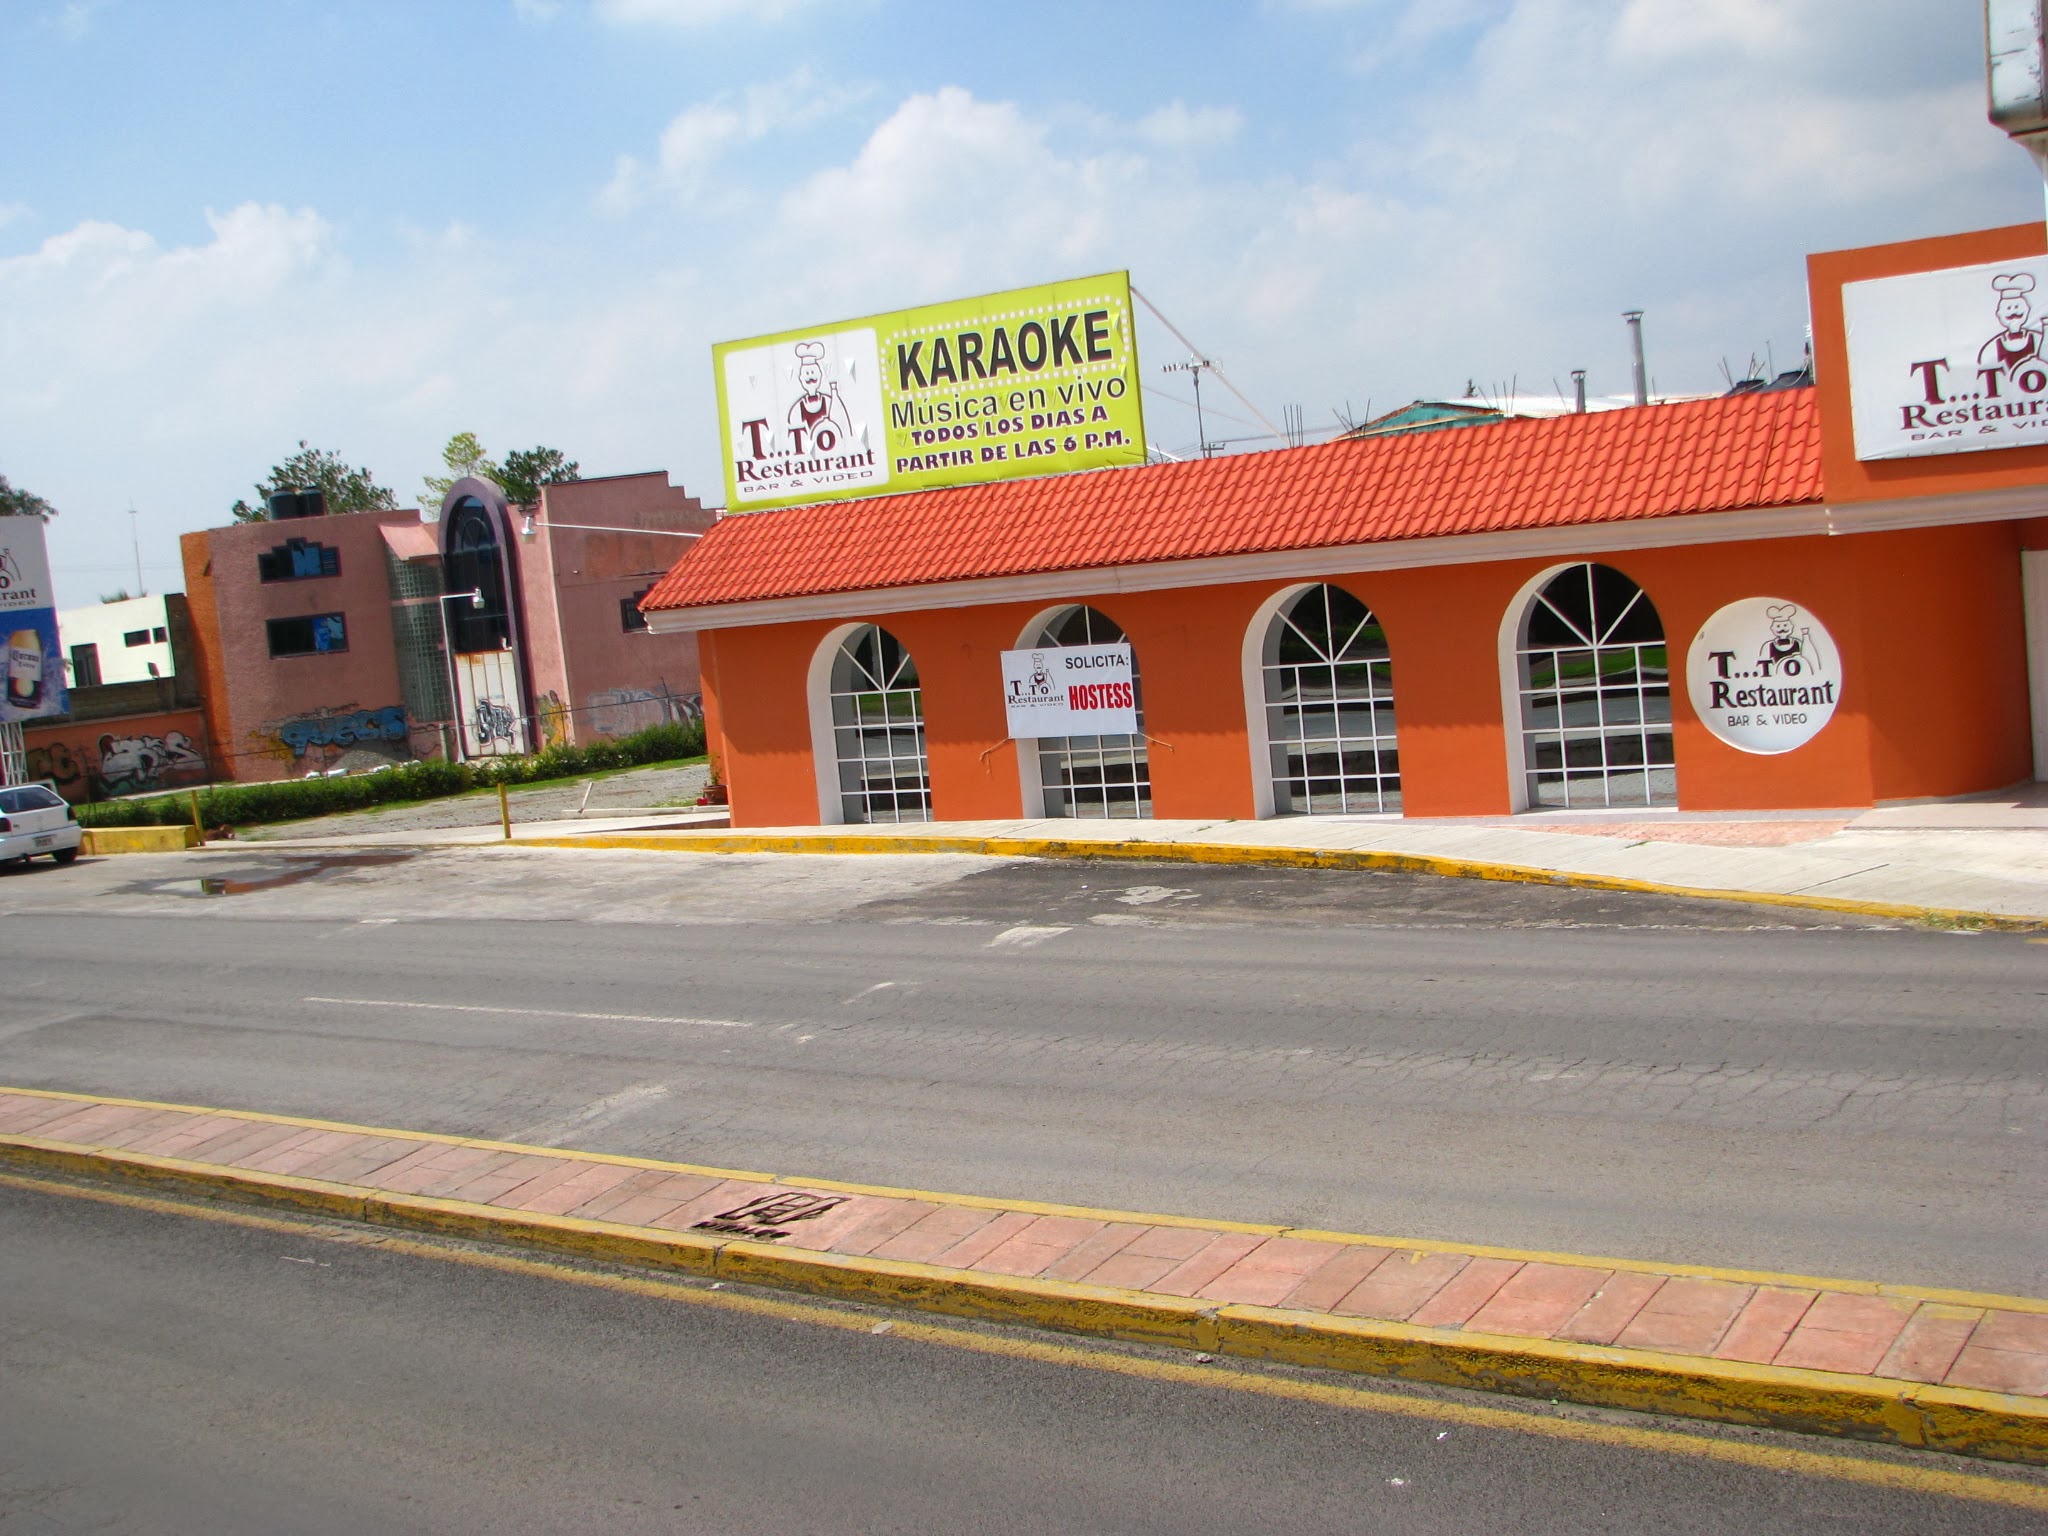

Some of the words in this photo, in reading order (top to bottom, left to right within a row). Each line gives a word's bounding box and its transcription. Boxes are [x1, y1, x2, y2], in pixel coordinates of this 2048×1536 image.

[897, 310, 1112, 391] KARAOKE
[891, 393, 998, 429] Música
[1009, 387, 1046, 412] en
[1057, 375, 1126, 405] vivo
[1899, 399, 2048, 430] Restaur
[911, 422, 978, 446] TODOS
[985, 417, 1024, 437] LOS
[1031, 408, 1085, 430] DIAS
[1091, 405, 1108, 422] A
[1911, 429, 1962, 441] BAR
[1978, 425, 1998, 434] &
[735, 449, 876, 483] Restaurant
[896, 449, 974, 473] PARTIR
[981, 445, 1008, 462] DE
[1015, 438, 1057, 458] LAS
[1063, 436, 1077, 452] 6
[1085, 430, 1131, 450] P.M.
[744, 483, 779, 493] BAR
[790, 479, 803, 487] &
[813, 470, 873, 484] VIDEO
[1065, 654, 1129, 669] SOLICITA:
[1008, 694, 1065, 704] Restaurant
[1068, 682, 1133, 711] HOSTESS
[1709, 680, 1834, 709] Restaurant
[1727, 715, 1750, 727] BAR
[1756, 714, 1768, 726] &
[1773, 713, 1808, 726] VIDEO
